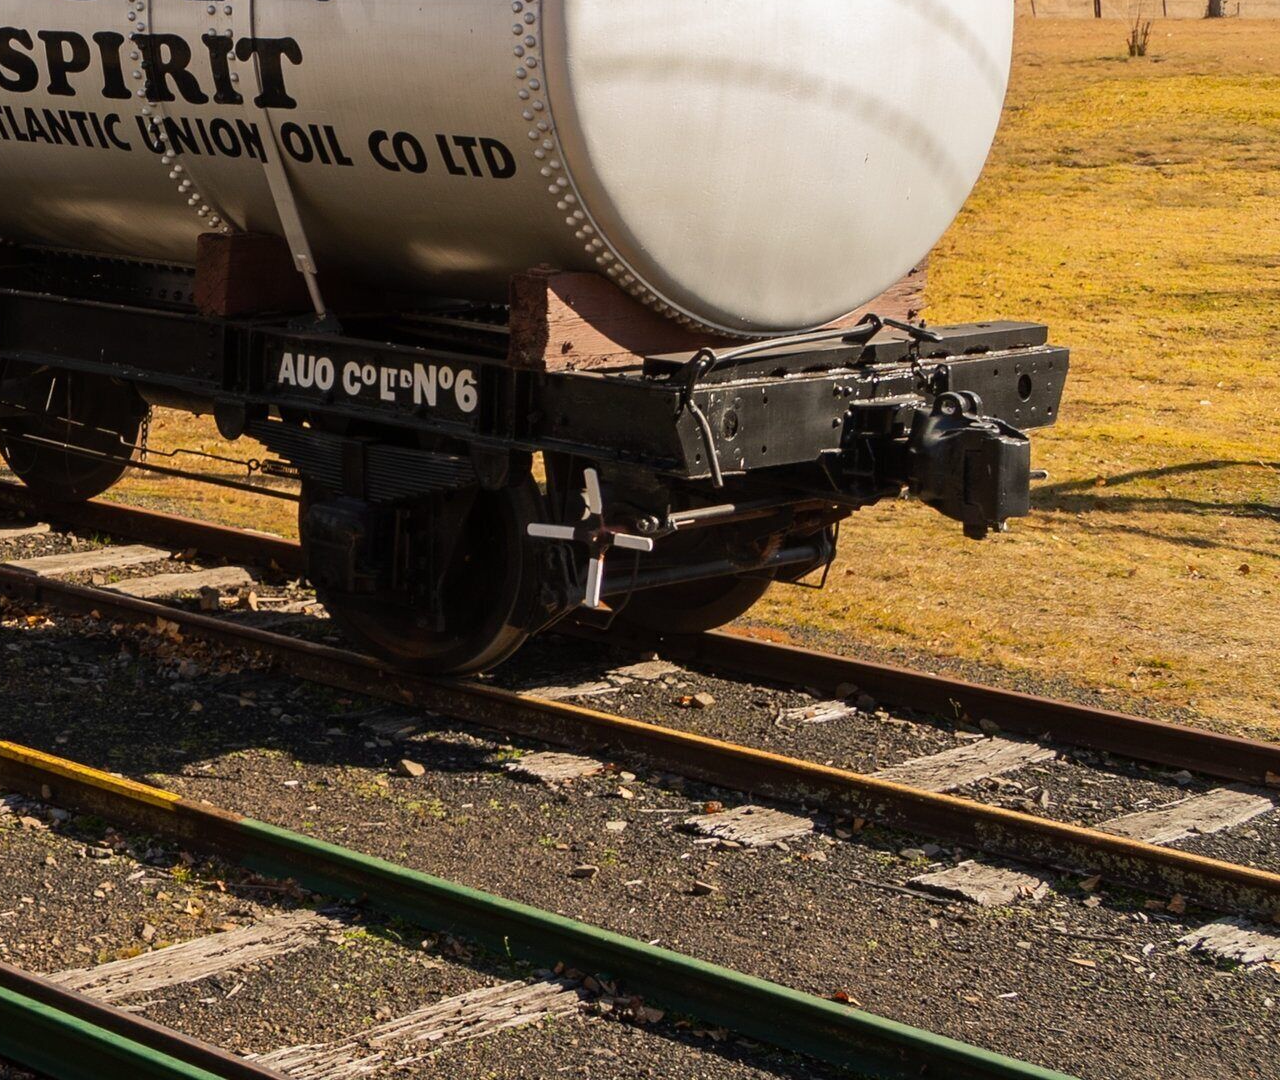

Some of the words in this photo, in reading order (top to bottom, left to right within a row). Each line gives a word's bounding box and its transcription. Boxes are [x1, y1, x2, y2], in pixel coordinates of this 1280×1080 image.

[135, 114, 268, 163] UNION
[280, 122, 354, 166] OIL
[368, 130, 428, 173] CO
[435, 134, 517, 179] LTD
[278, 353, 335, 390] AUO
